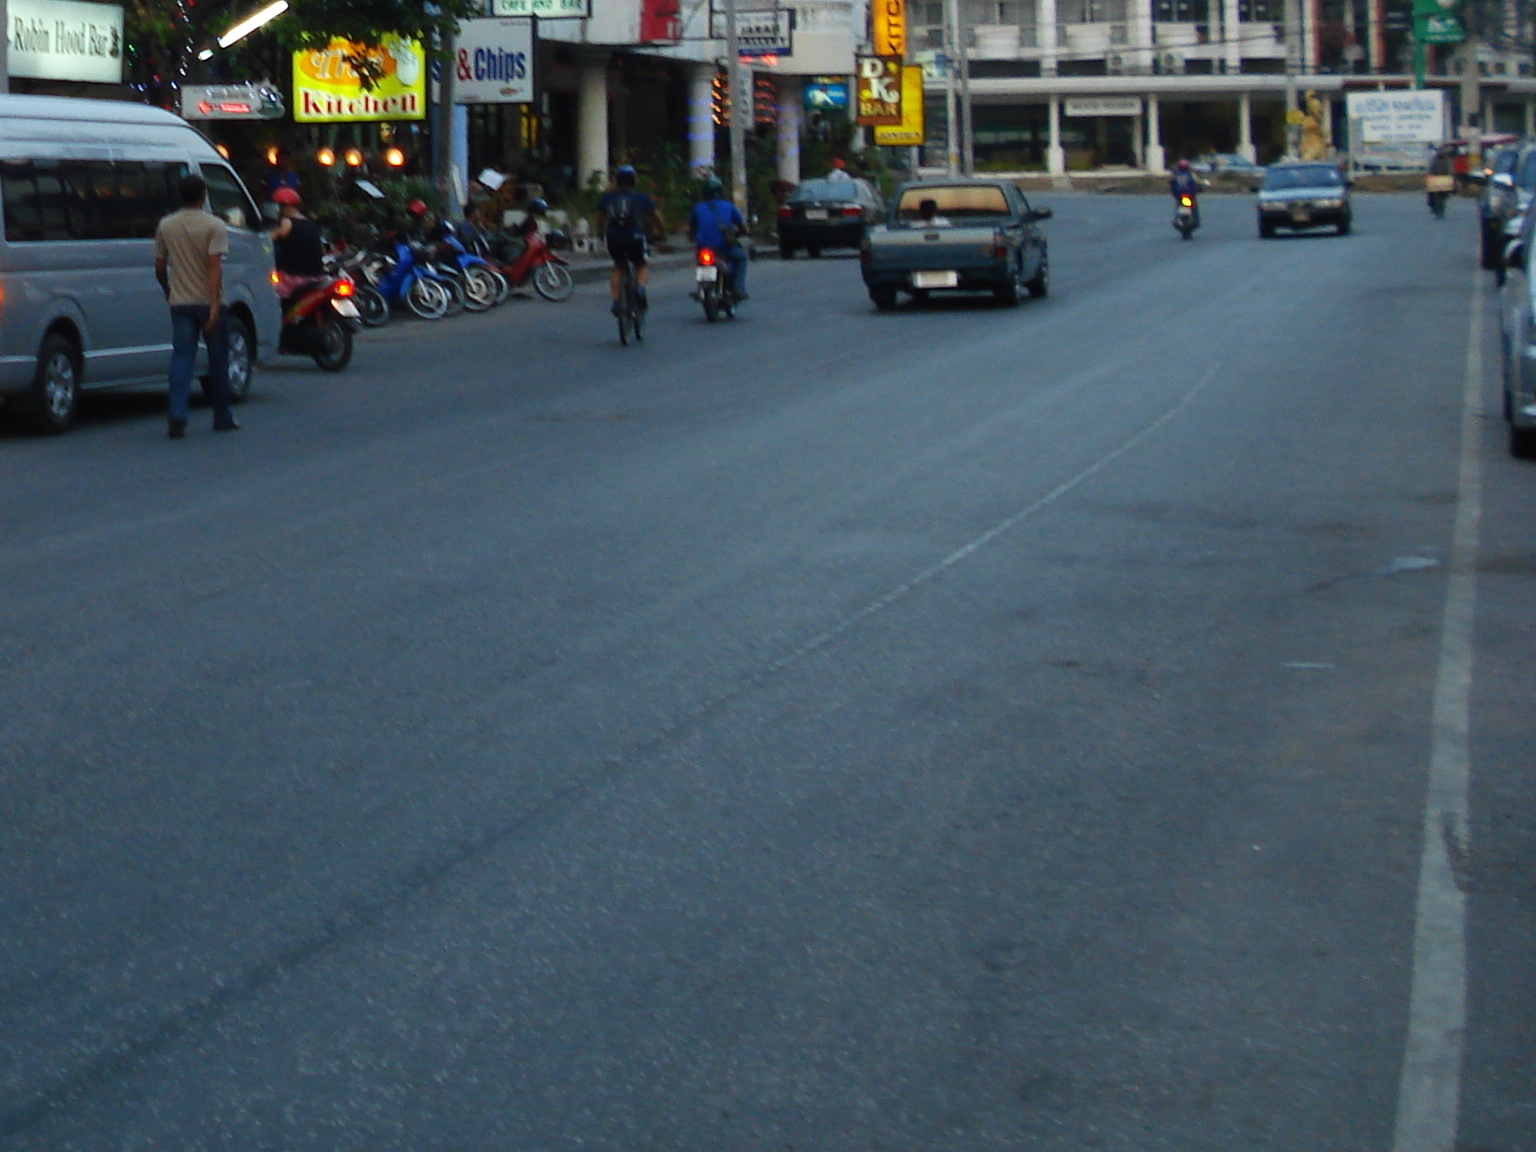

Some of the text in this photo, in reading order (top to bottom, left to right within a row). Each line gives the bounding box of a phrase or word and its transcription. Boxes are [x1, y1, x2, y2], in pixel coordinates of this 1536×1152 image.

[14, 16, 51, 54] Robin
[55, 19, 86, 56] Hood
[457, 46, 526, 84] & Chips
